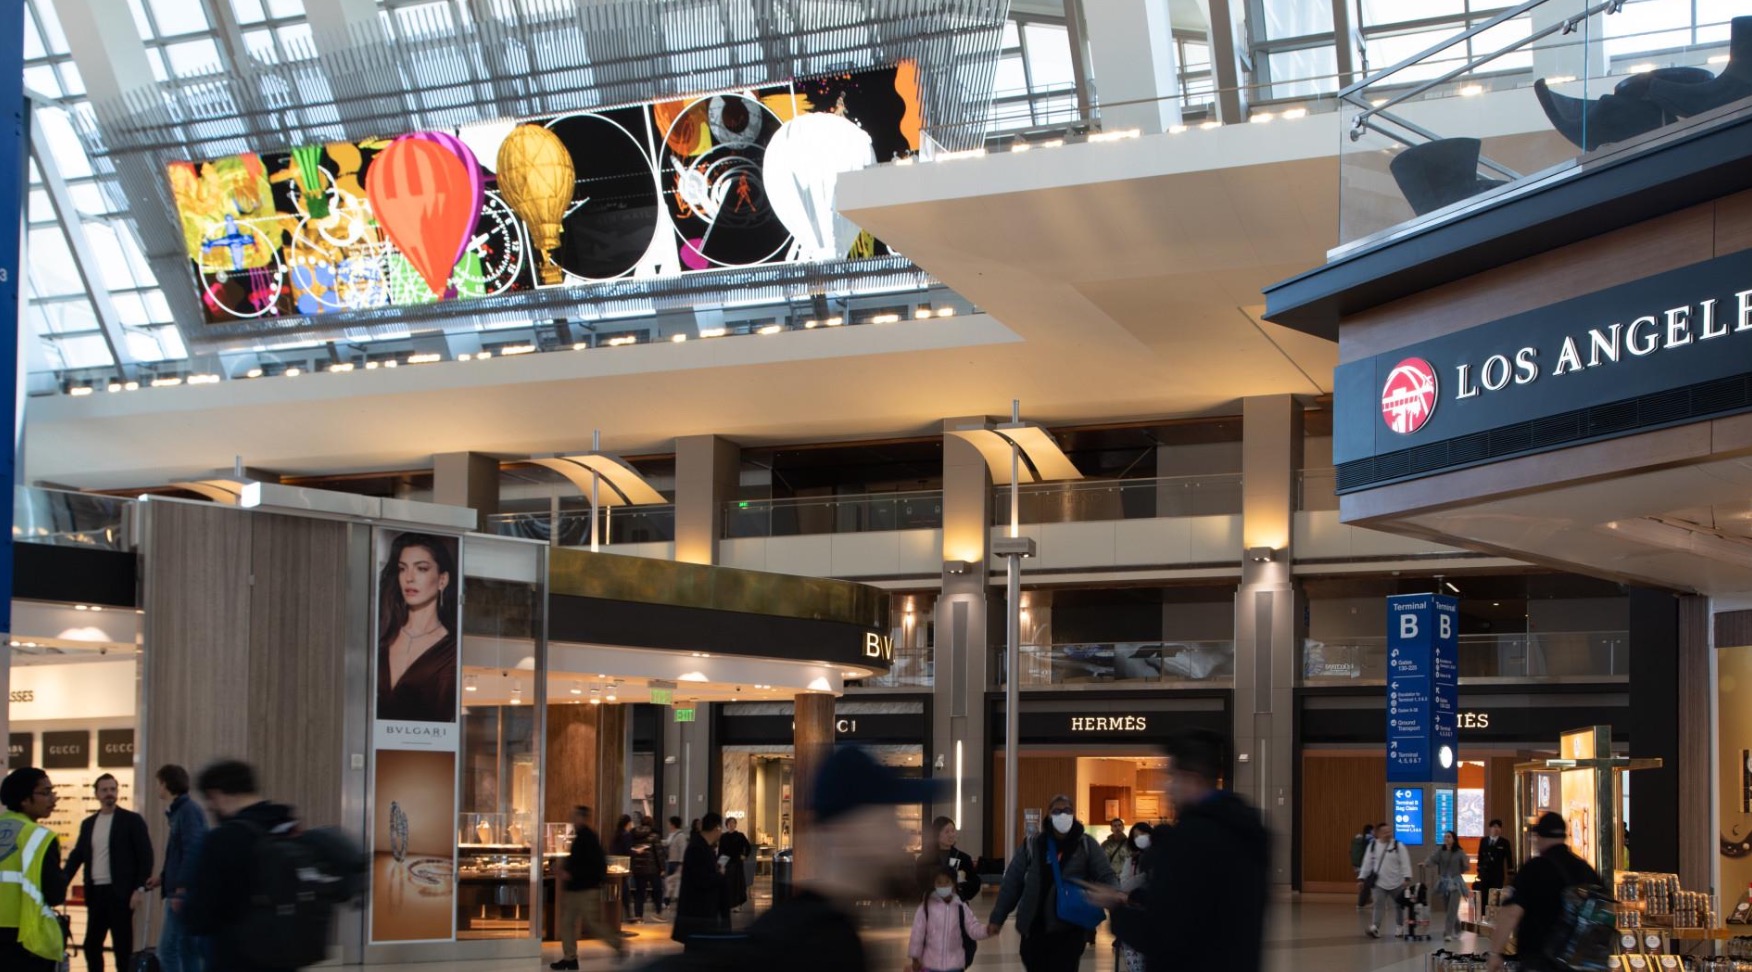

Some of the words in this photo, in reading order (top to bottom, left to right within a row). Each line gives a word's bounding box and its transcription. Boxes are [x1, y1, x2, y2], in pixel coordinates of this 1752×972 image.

[1455, 346, 1539, 400] LOS
[1393, 601, 1427, 611] Terminal
[1435, 601, 1456, 612] Terminal
[1400, 613, 1419, 639] B
[1440, 613, 1451, 640] B
[386, 725, 447, 736] BVLGARI
[49, 745, 80, 754] GUCCI
